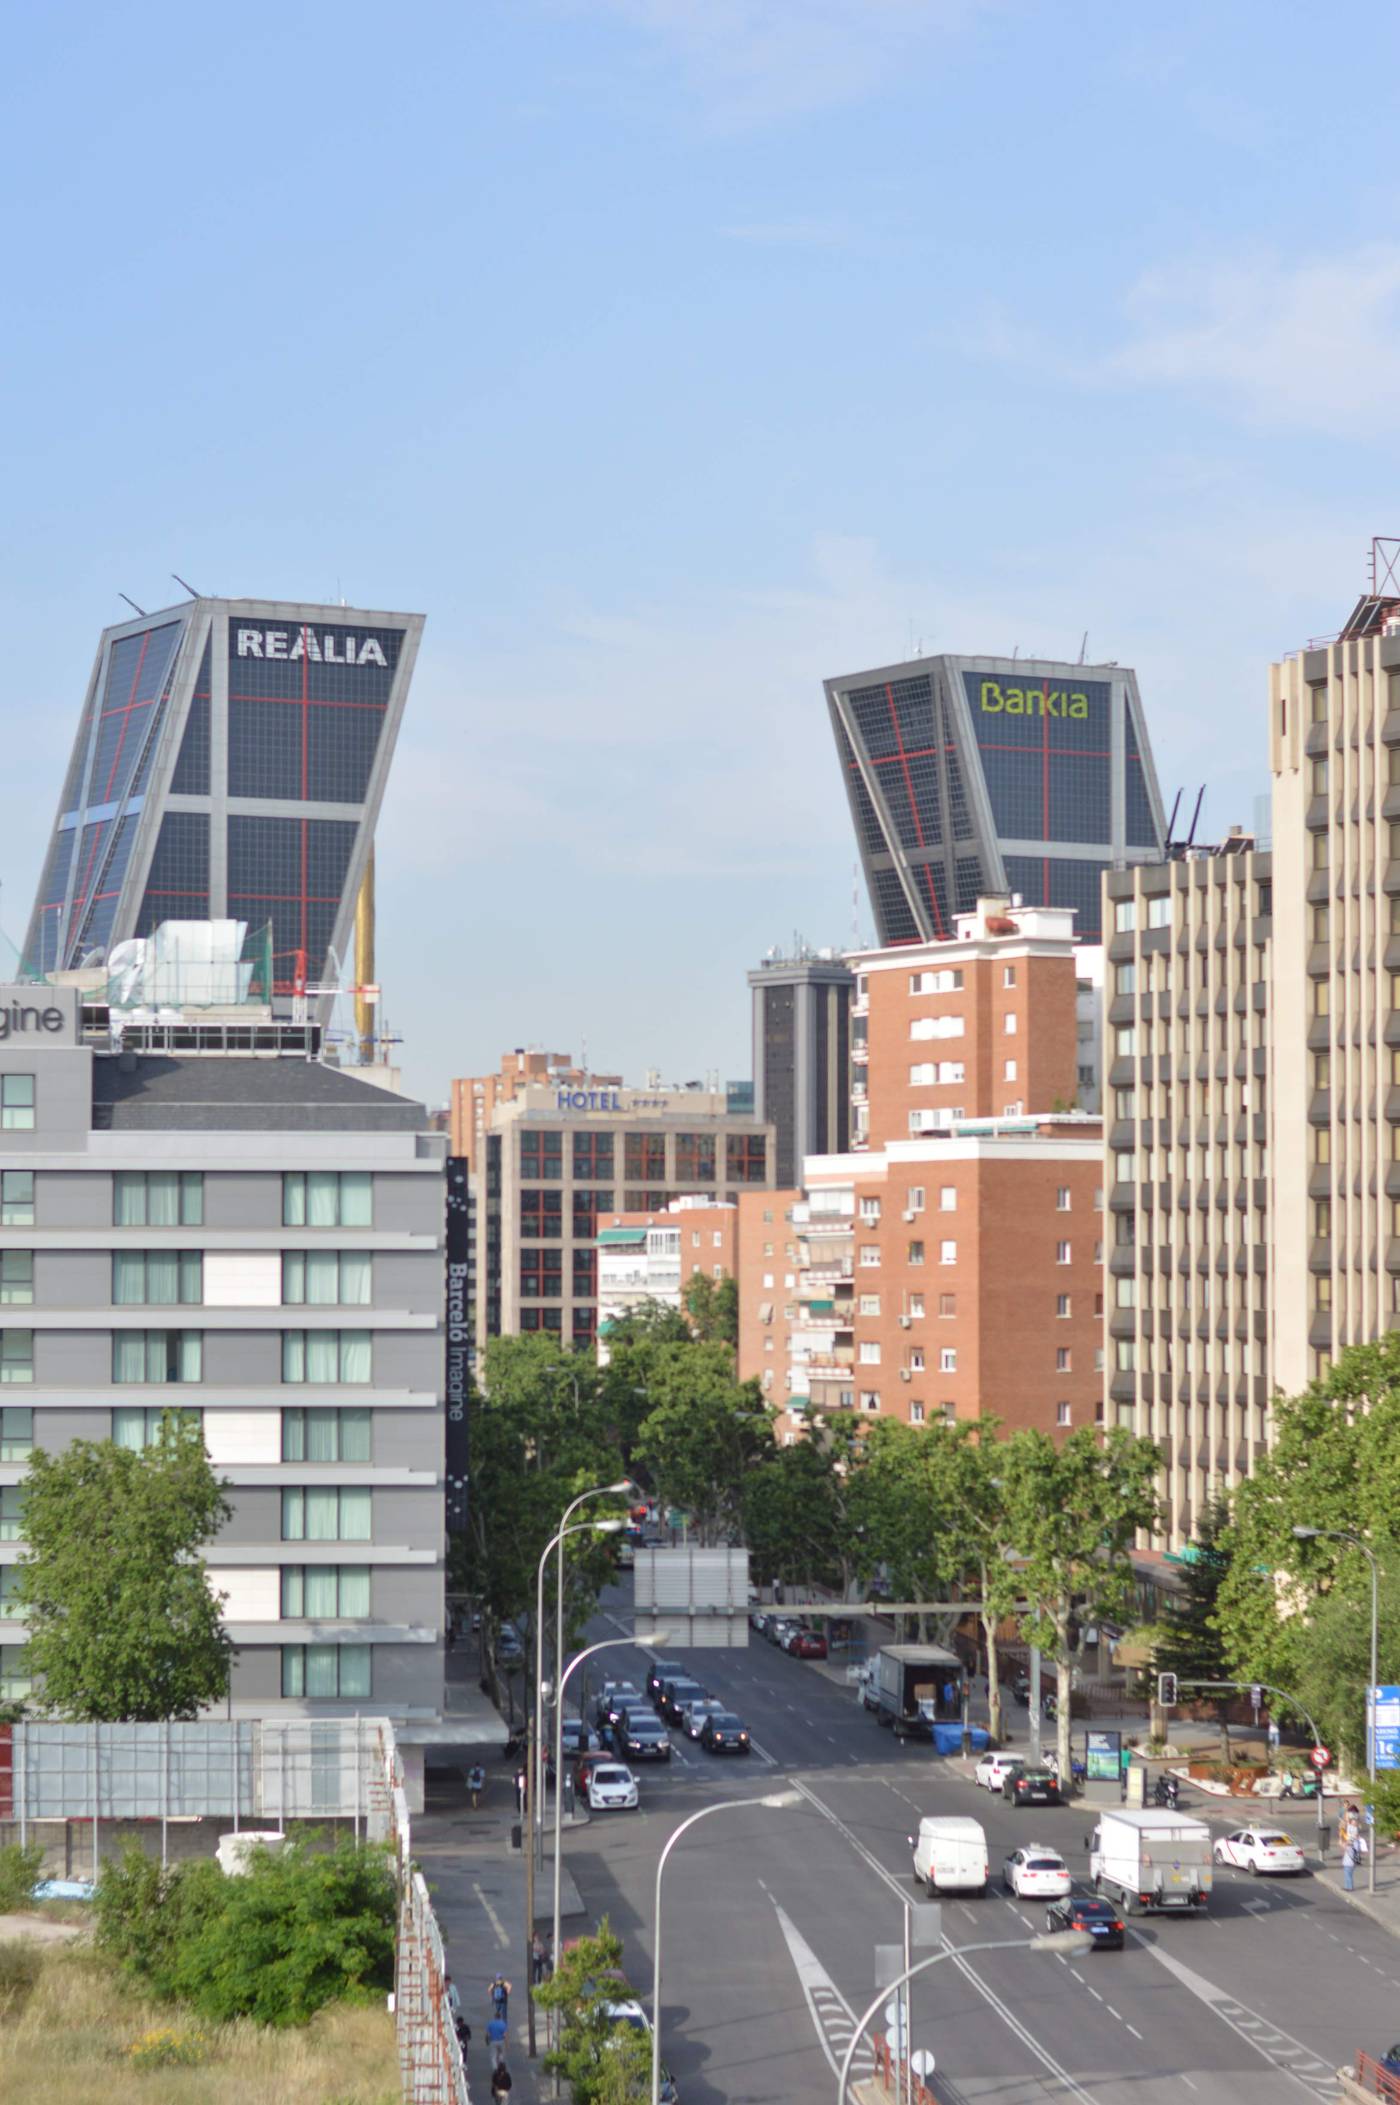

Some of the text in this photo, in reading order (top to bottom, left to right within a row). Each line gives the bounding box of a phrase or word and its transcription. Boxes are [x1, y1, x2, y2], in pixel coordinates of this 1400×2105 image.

[237, 627, 388, 667] REALIA
[981, 682, 1088, 718] Bankia
[557, 1091, 623, 1111] HOTEL
[448, 1263, 469, 1421] Barceló Imagine
